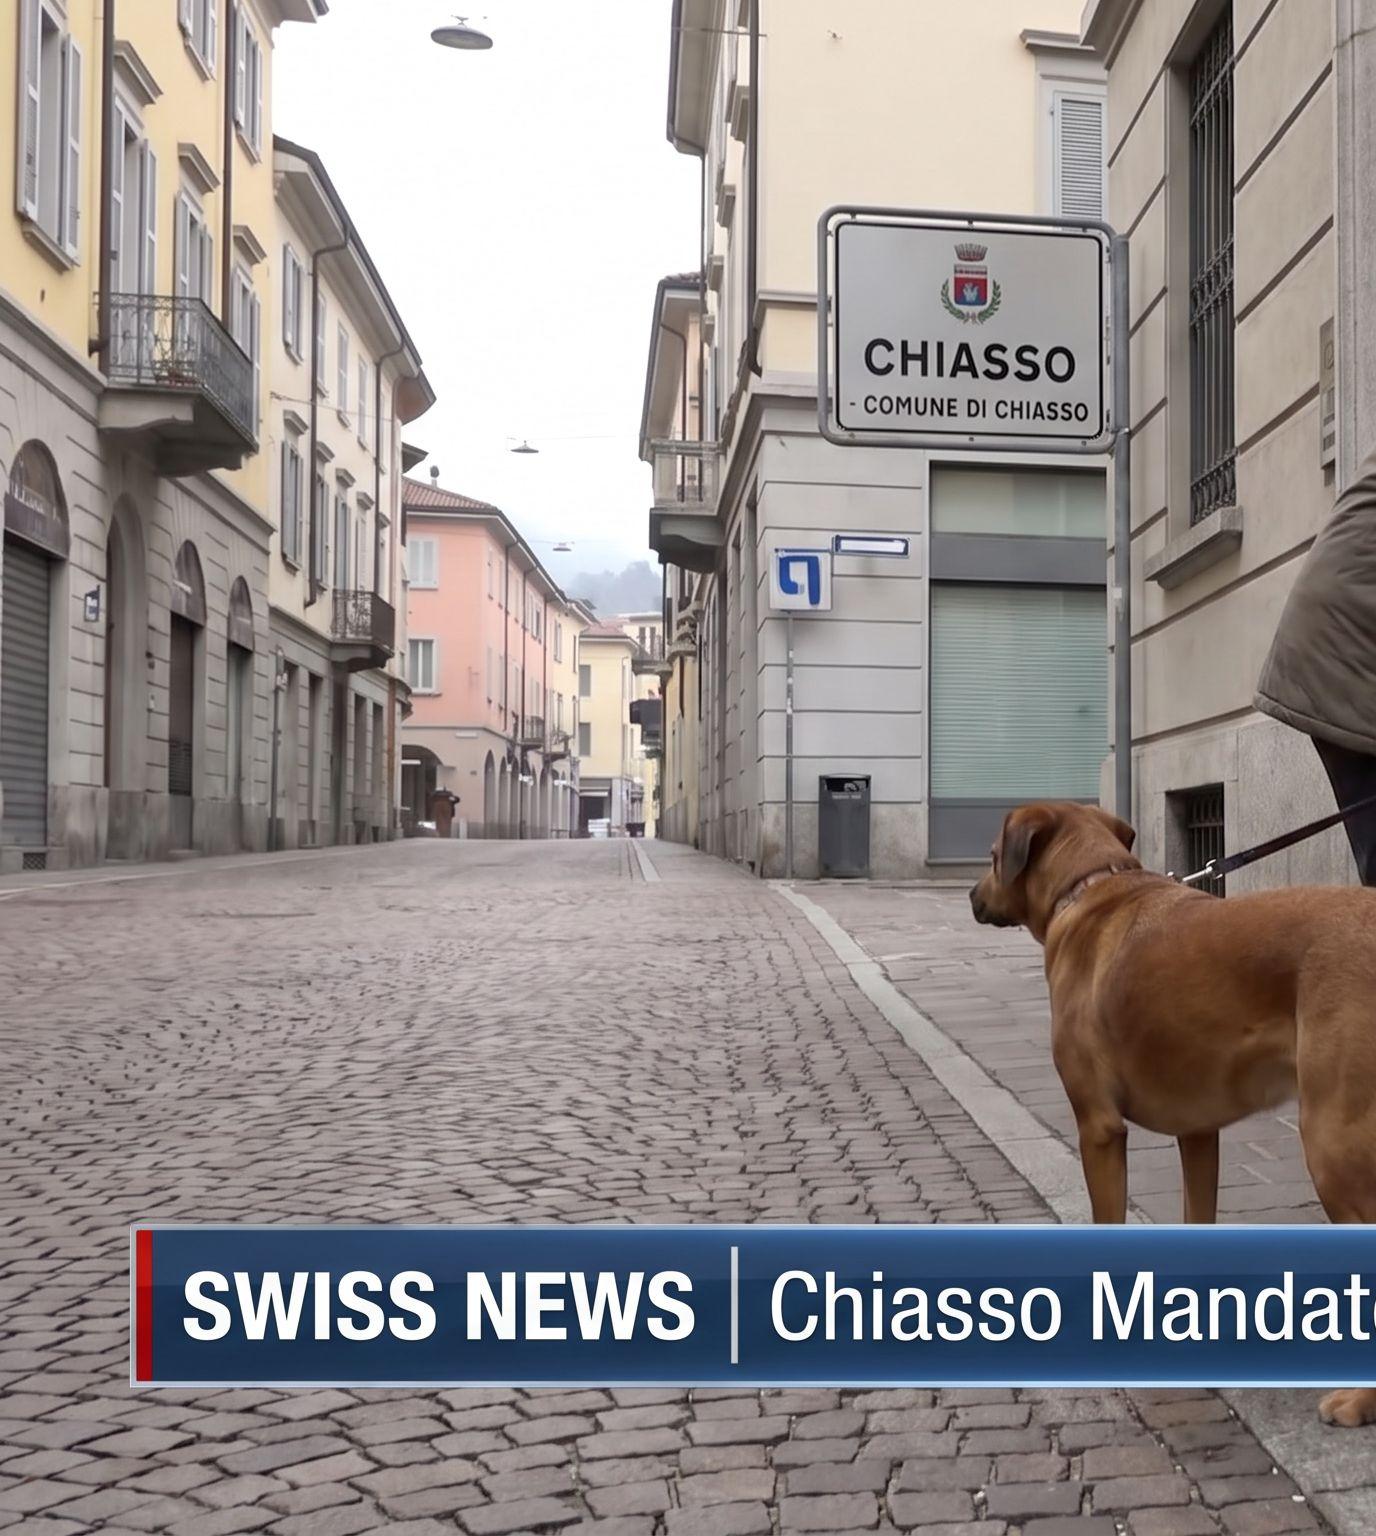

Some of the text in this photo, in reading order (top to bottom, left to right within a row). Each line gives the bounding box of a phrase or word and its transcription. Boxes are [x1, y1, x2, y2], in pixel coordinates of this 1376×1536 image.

[864, 338, 1076, 383] CHIASSO
[863, 395, 958, 418] COMUNE
[966, 398, 987, 419] DI
[995, 400, 1089, 422] CHIASSO
